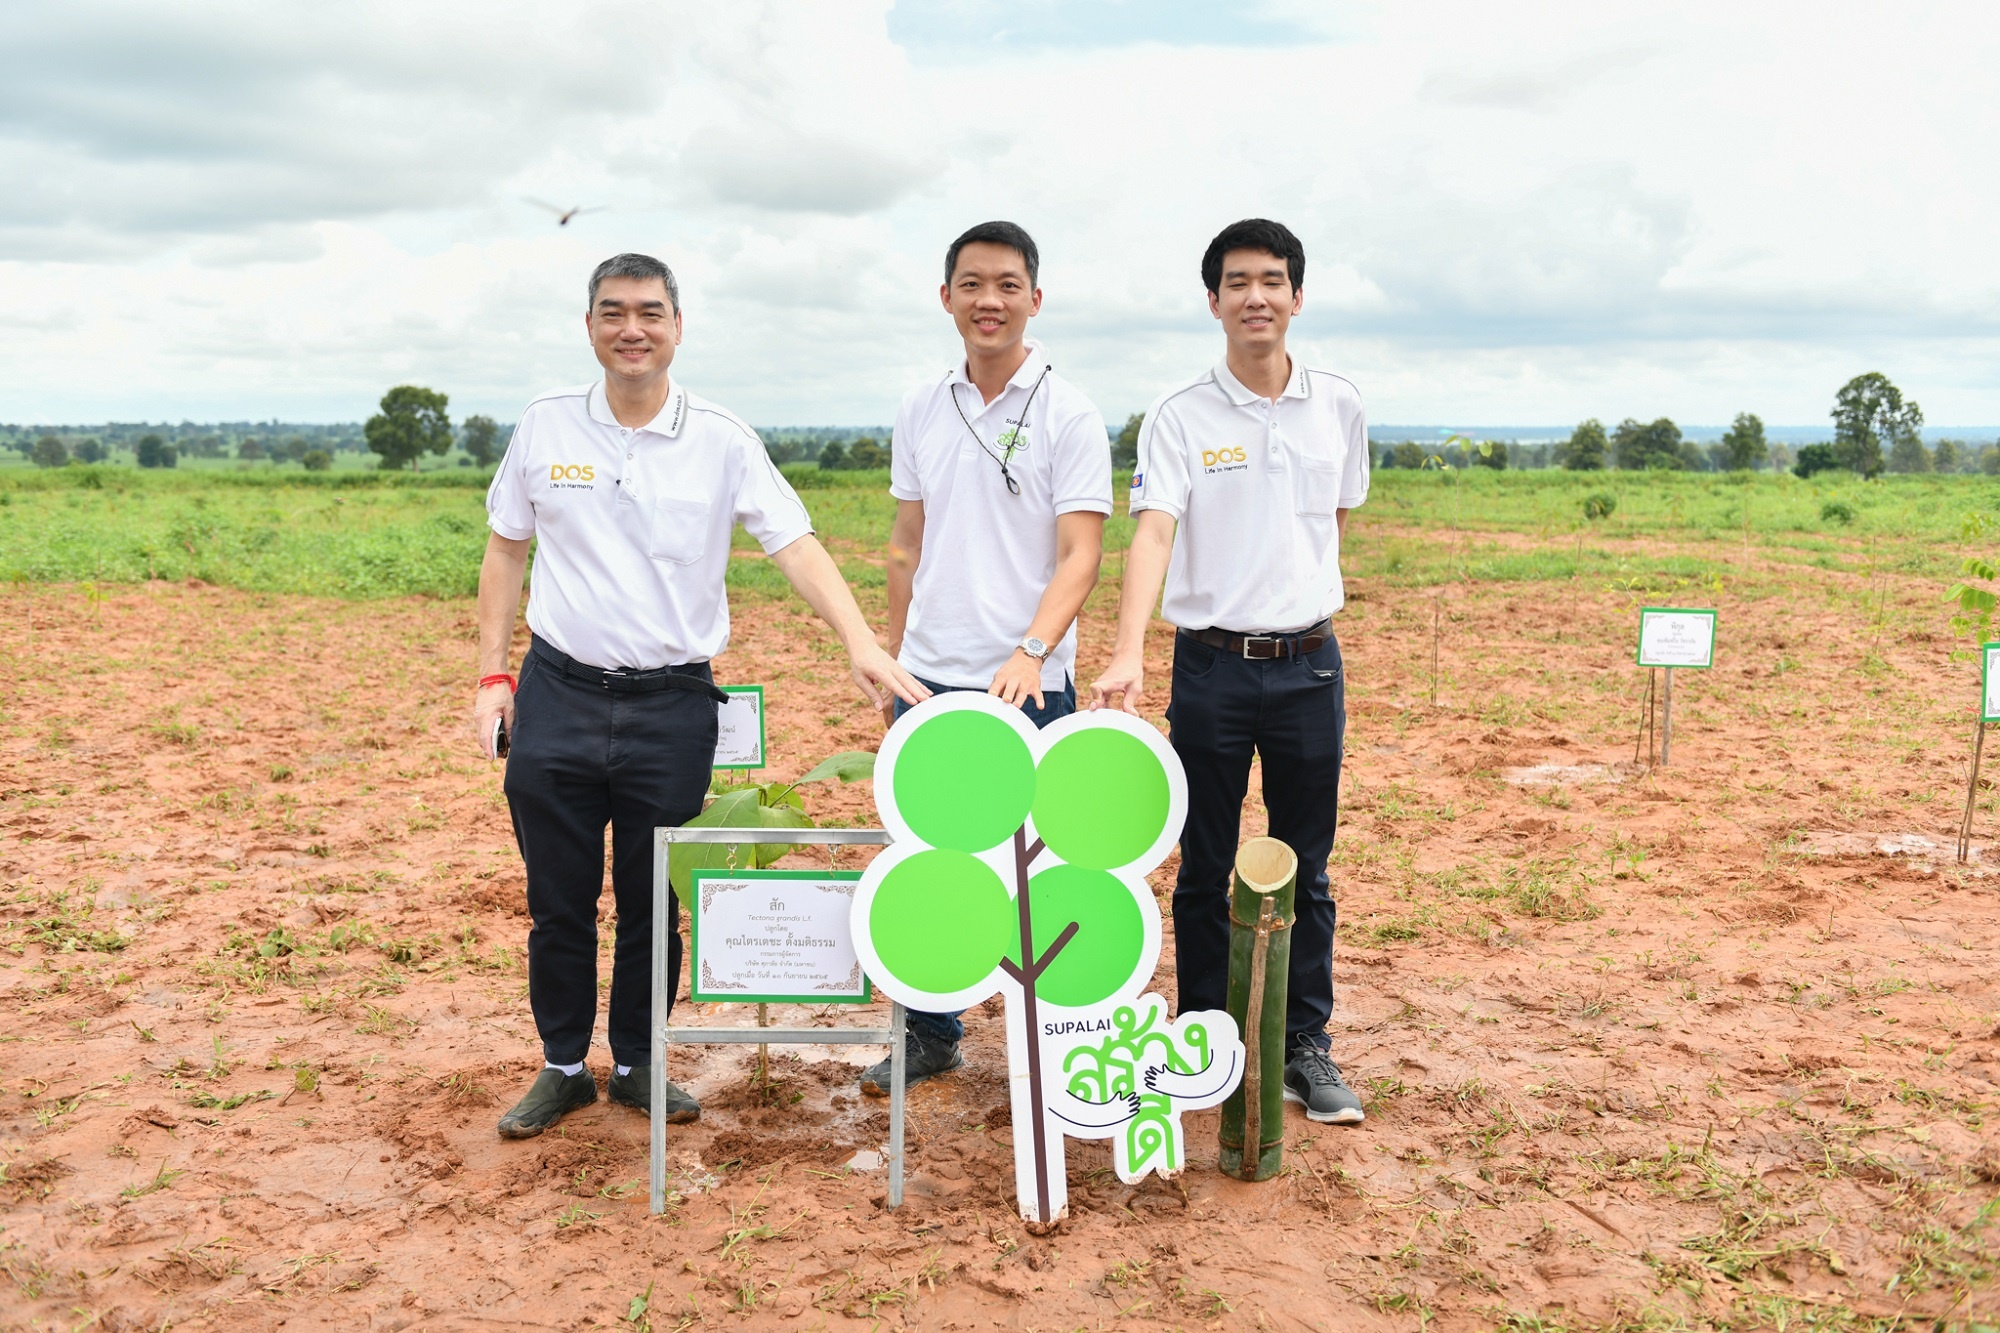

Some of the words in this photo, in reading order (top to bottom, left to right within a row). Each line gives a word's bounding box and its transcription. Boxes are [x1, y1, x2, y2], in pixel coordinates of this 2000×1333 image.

[1202, 446, 1247, 466] DOS
[551, 464, 595, 481] DOS
[769, 897, 785, 911] สัก
[776, 914, 801, 922] grandis
[765, 924, 788, 934] ปลูกโดย
[725, 934, 782, 949] คุณไตรเตชะ
[785, 932, 836, 948] ตั้งมติธรรม
[732, 969, 756, 981] ปลูกเมื่อ
[757, 969, 770, 979] วันที่
[783, 971, 808, 980] กันยายน
[1044, 1018, 1111, 1036] SUPALAI
